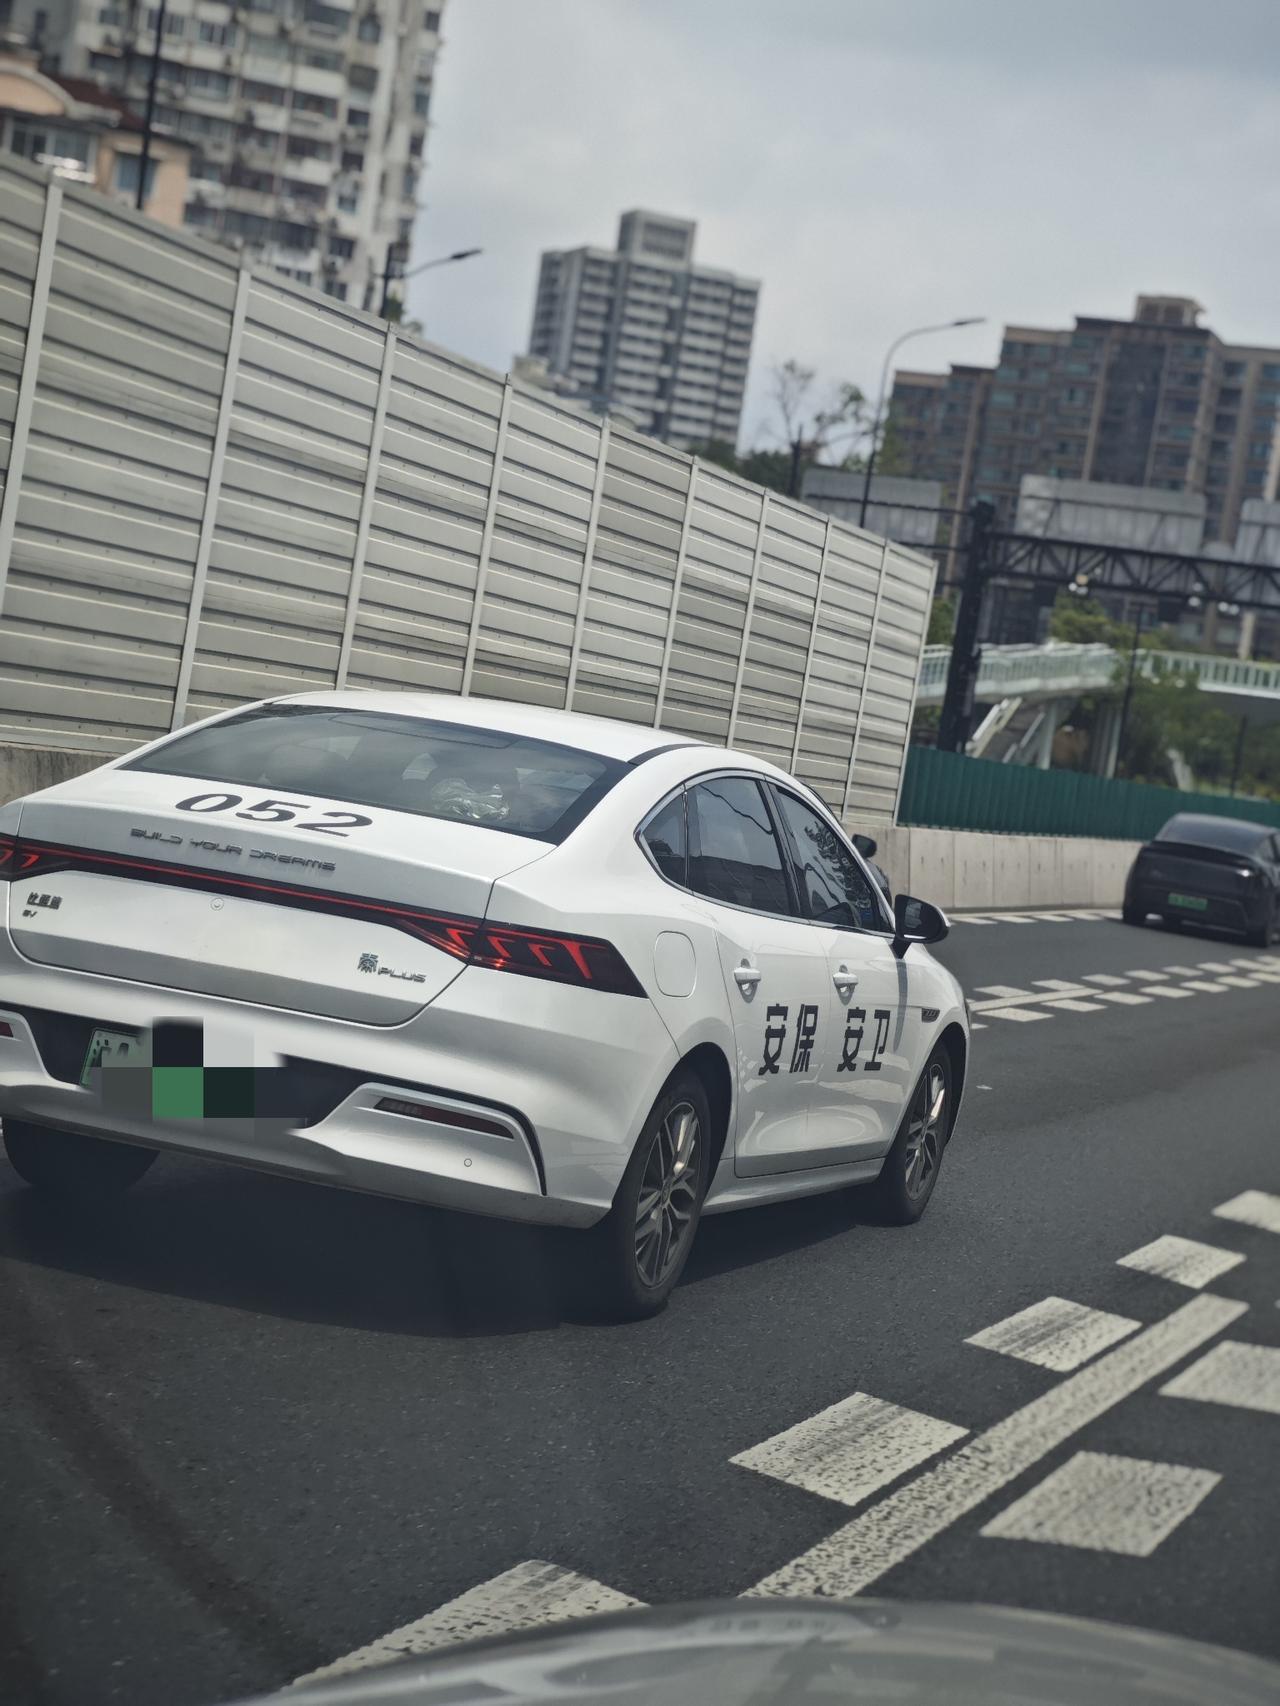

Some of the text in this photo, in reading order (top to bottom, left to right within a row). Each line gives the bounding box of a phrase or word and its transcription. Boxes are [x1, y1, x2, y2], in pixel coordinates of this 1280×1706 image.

[175, 793, 372, 837] 052
[130, 828, 336, 872] BUILD YOUR DREAMS
